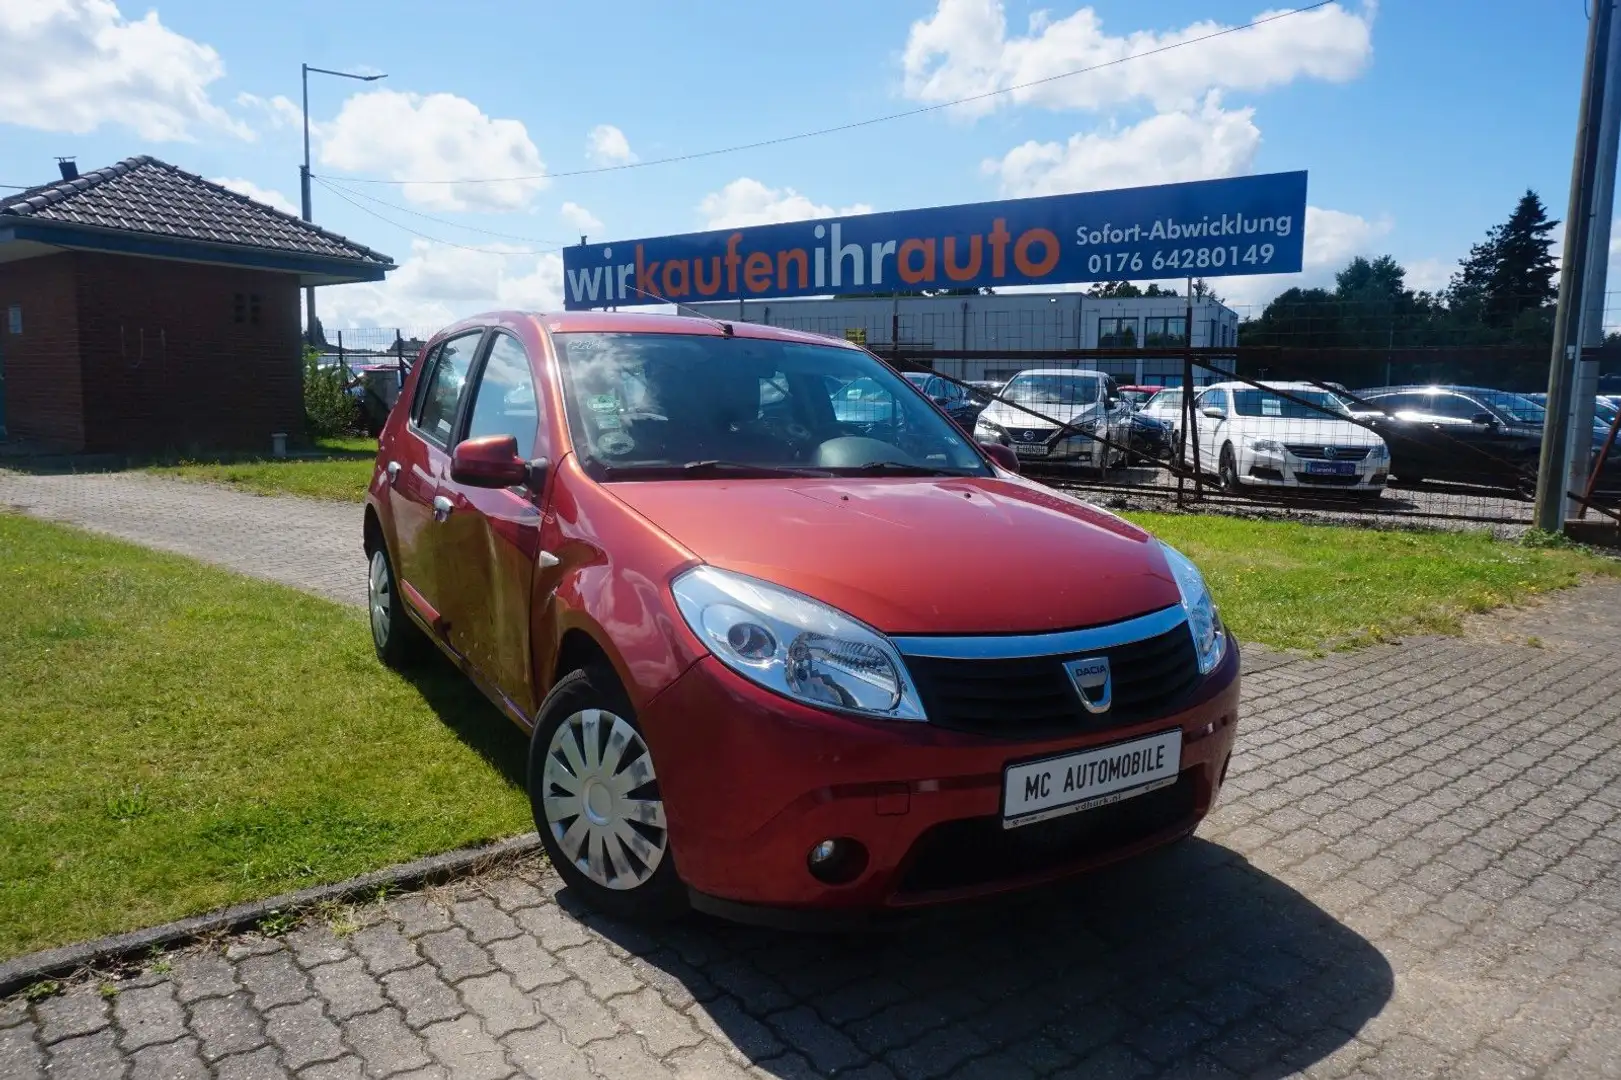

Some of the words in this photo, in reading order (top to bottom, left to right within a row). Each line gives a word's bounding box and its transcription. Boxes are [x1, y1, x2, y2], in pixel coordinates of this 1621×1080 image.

[1076, 212, 1292, 246] Sofort-Abwicklung
[1088, 251, 1143, 274] 0176
[1151, 243, 1274, 270] 64280149
[1075, 664, 1106, 677] DACIA
[1024, 771, 1051, 801] MC
[1063, 745, 1165, 793] AUTOMOBILE
